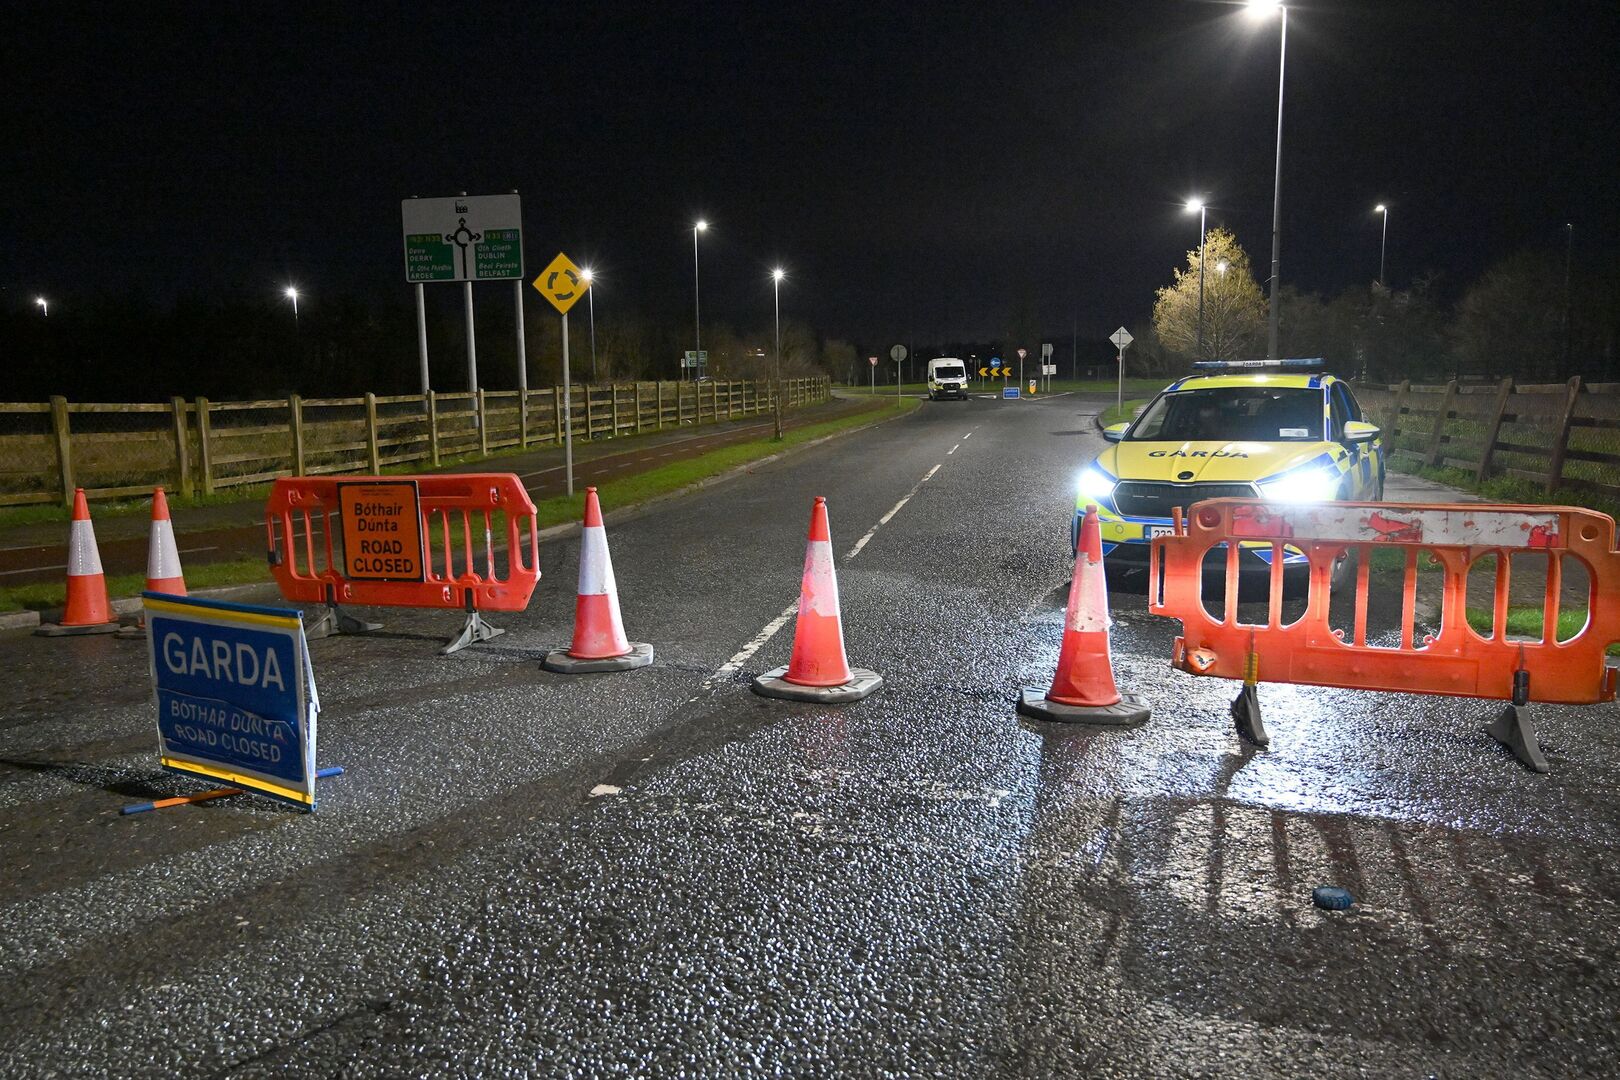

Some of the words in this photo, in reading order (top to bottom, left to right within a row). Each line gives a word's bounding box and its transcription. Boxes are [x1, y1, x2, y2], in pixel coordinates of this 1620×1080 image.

[478, 252, 505, 260] DUBLIN
[479, 269, 511, 278] BELFAST
[1148, 450, 1249, 459] GARDA
[354, 502, 403, 516] Bóthair
[357, 517, 398, 532] Dúnta
[361, 540, 403, 554] ROAD
[353, 558, 414, 573] CLOSED
[163, 631, 286, 692] GARDA
[174, 723, 218, 747] ROAD
[221, 732, 281, 763] CLOSED
